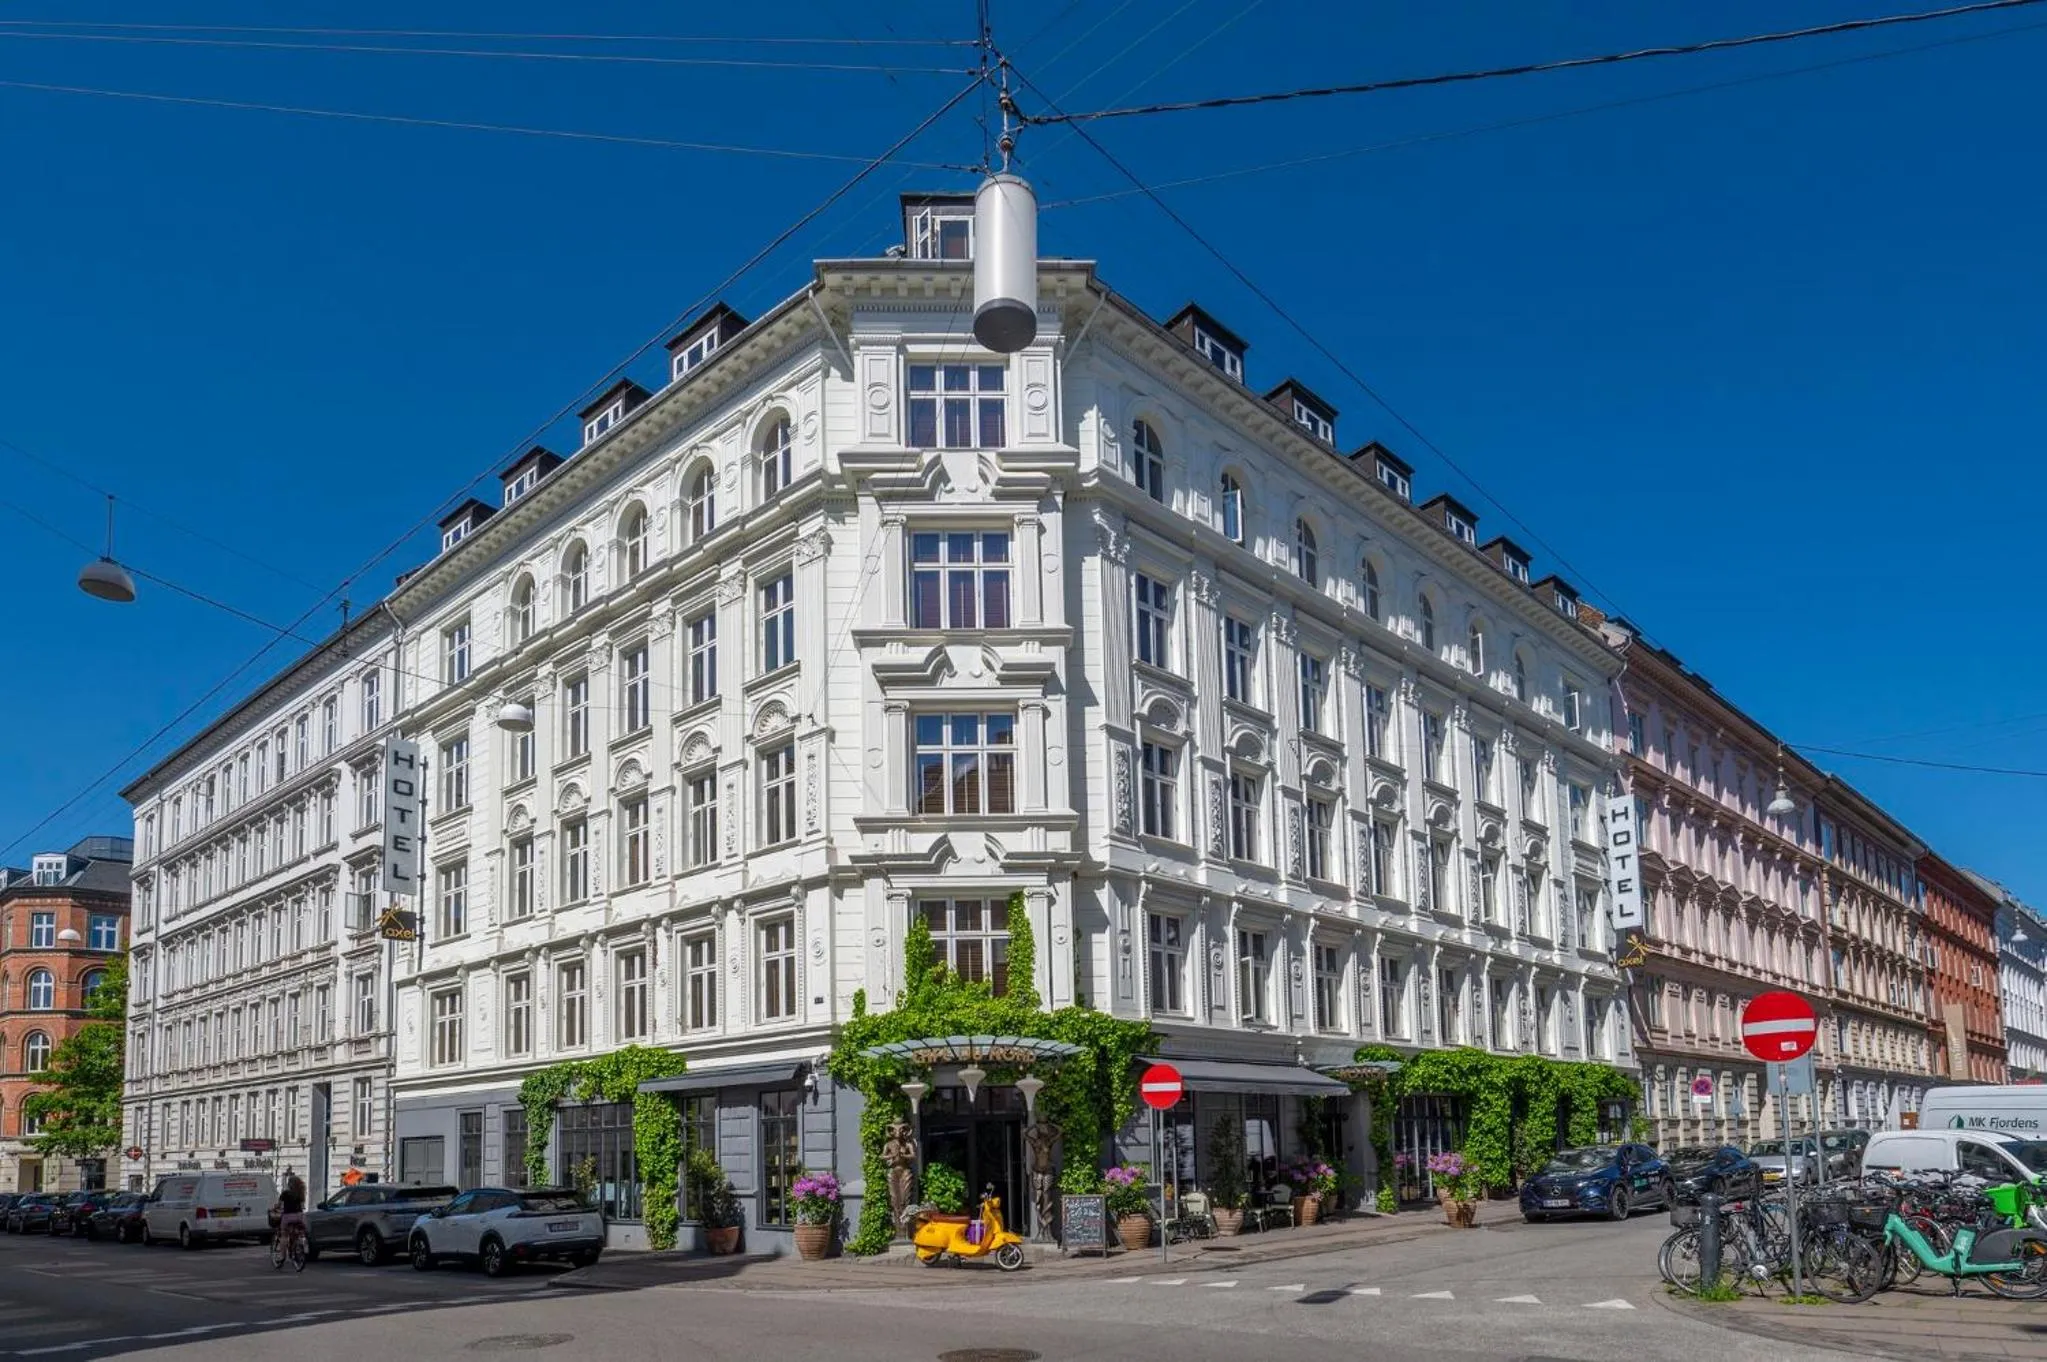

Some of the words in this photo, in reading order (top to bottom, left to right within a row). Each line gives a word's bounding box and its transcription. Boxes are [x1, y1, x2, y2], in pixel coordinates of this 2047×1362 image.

[393, 750, 414, 881] HOTEL
[1611, 806, 1634, 918] HOTEL
[385, 927, 415, 940] axel
[1968, 1117, 1986, 1128] MK
[1990, 1116, 2039, 1129] Fjordens
